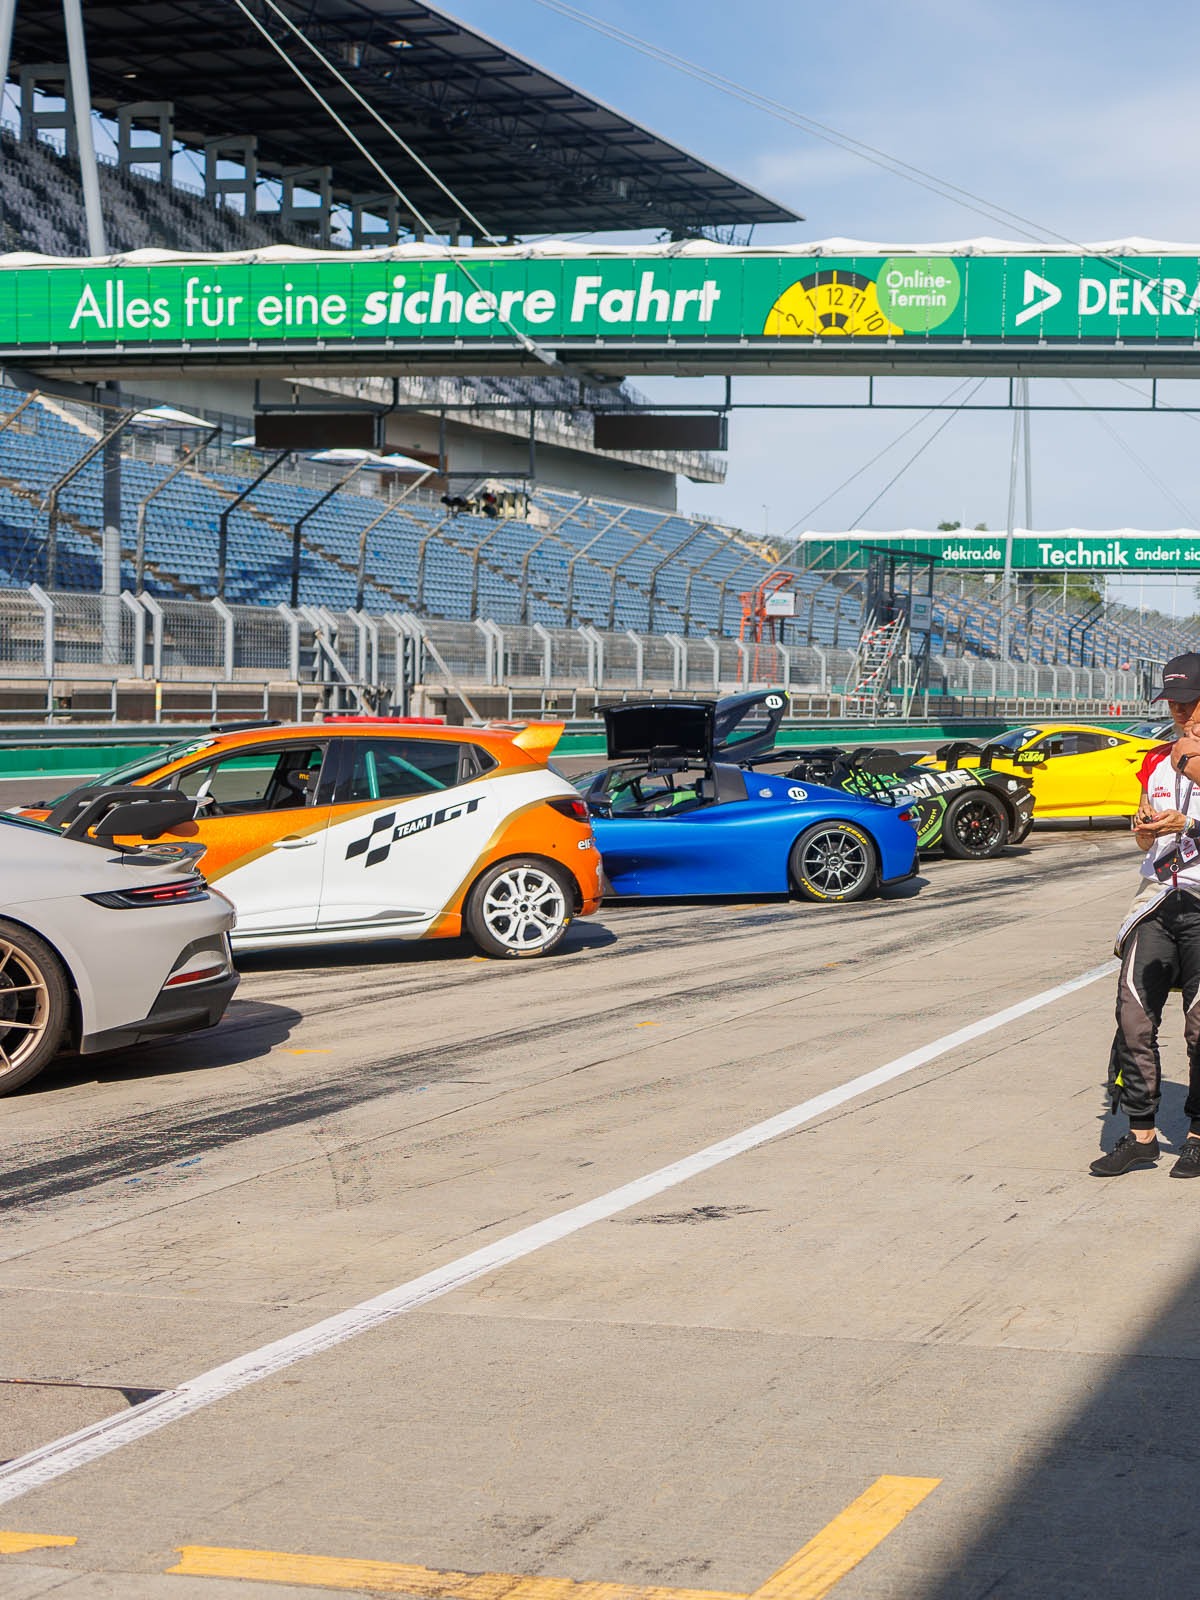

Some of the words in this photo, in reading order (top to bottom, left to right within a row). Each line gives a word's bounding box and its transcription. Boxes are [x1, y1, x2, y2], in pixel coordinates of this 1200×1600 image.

[886, 269, 952, 288] Online-
[69, 278, 171, 328] Alles
[184, 277, 243, 327] für
[257, 295, 347, 326] eine
[362, 274, 556, 325] sichere
[570, 272, 721, 322] Fahrt
[889, 290, 947, 306] Termin
[827, 287, 844, 306] 12
[864, 310, 885, 332] 10
[942, 545, 1002, 561] dekra.de
[1038, 542, 1129, 565] Technik
[1135, 545, 1182, 561] ändert
[792, 789, 806, 798] 10
[397, 817, 427, 838] TEAM
